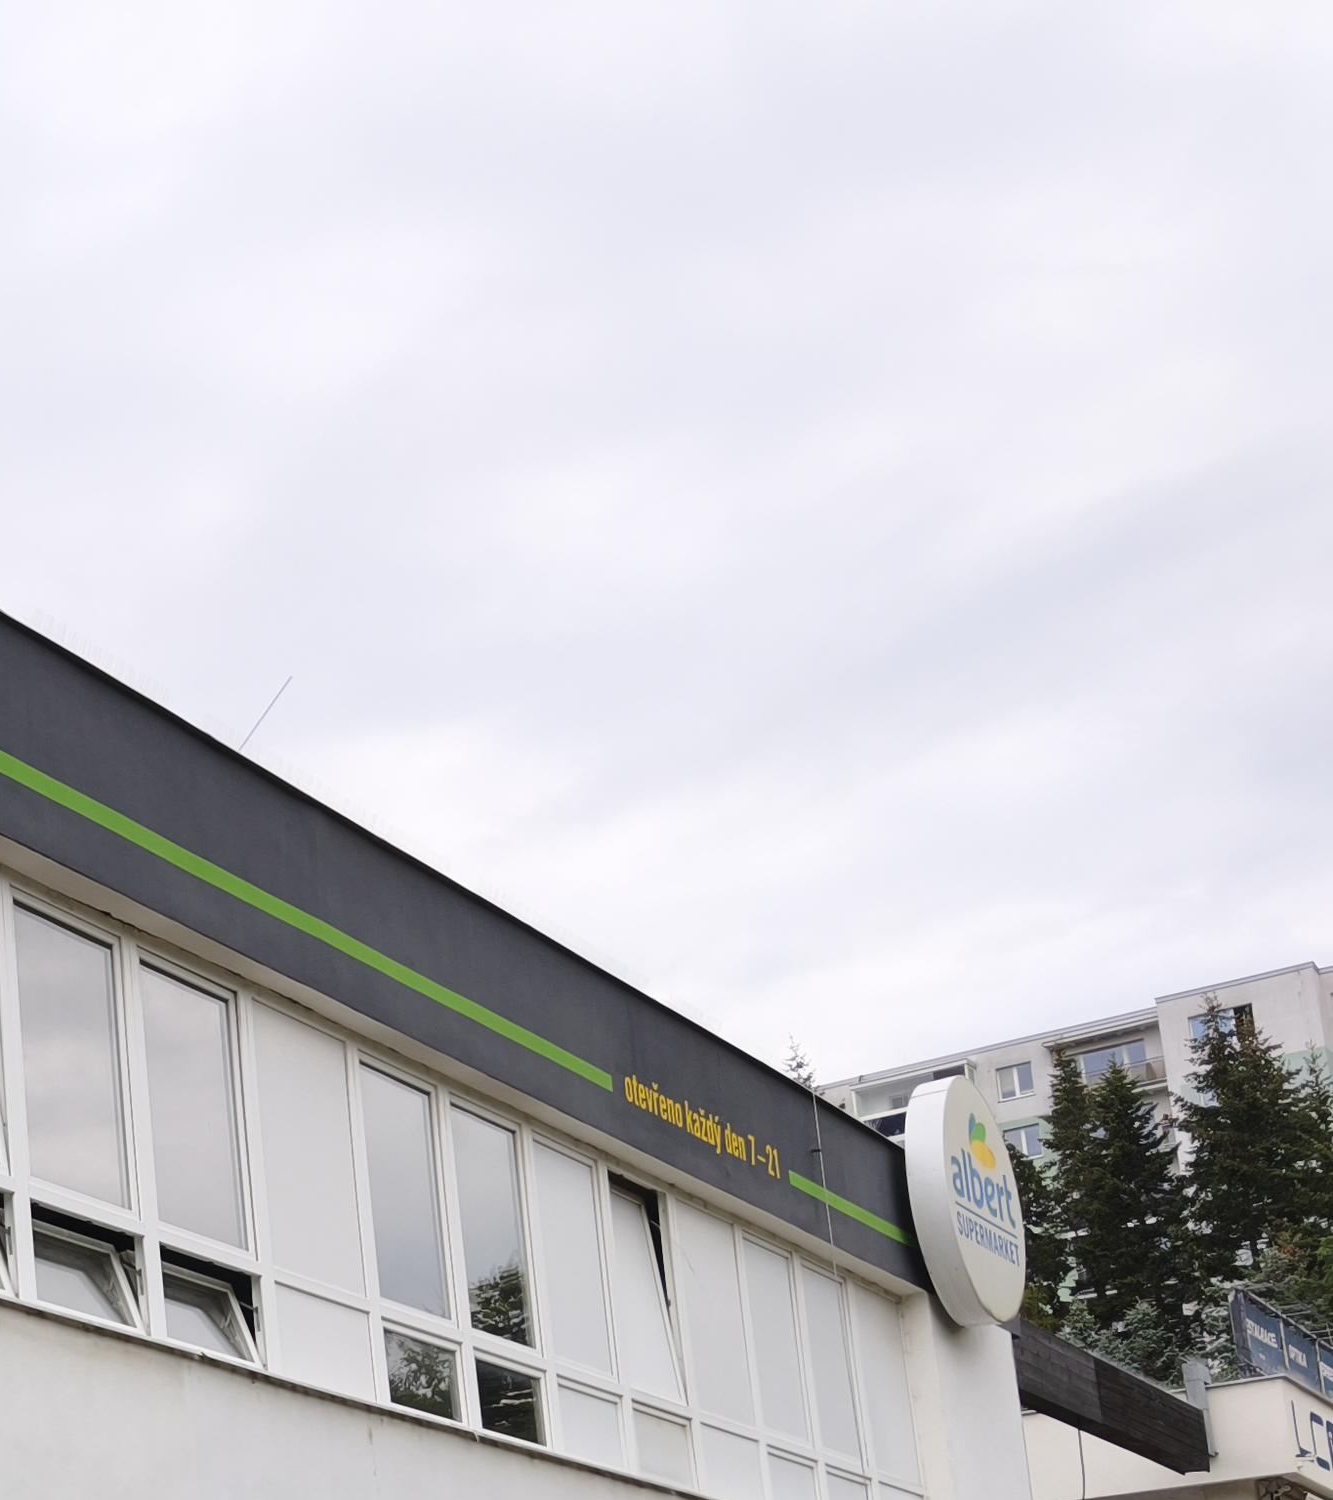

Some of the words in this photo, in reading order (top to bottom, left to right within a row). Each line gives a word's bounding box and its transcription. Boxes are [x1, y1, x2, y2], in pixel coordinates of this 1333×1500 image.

[624, 1074, 684, 1128] otevřeno
[684, 1100, 722, 1154] každý
[725, 1122, 747, 1161] den
[950, 1147, 1016, 1230] albert
[956, 1210, 1020, 1267] SUPERMARKET
